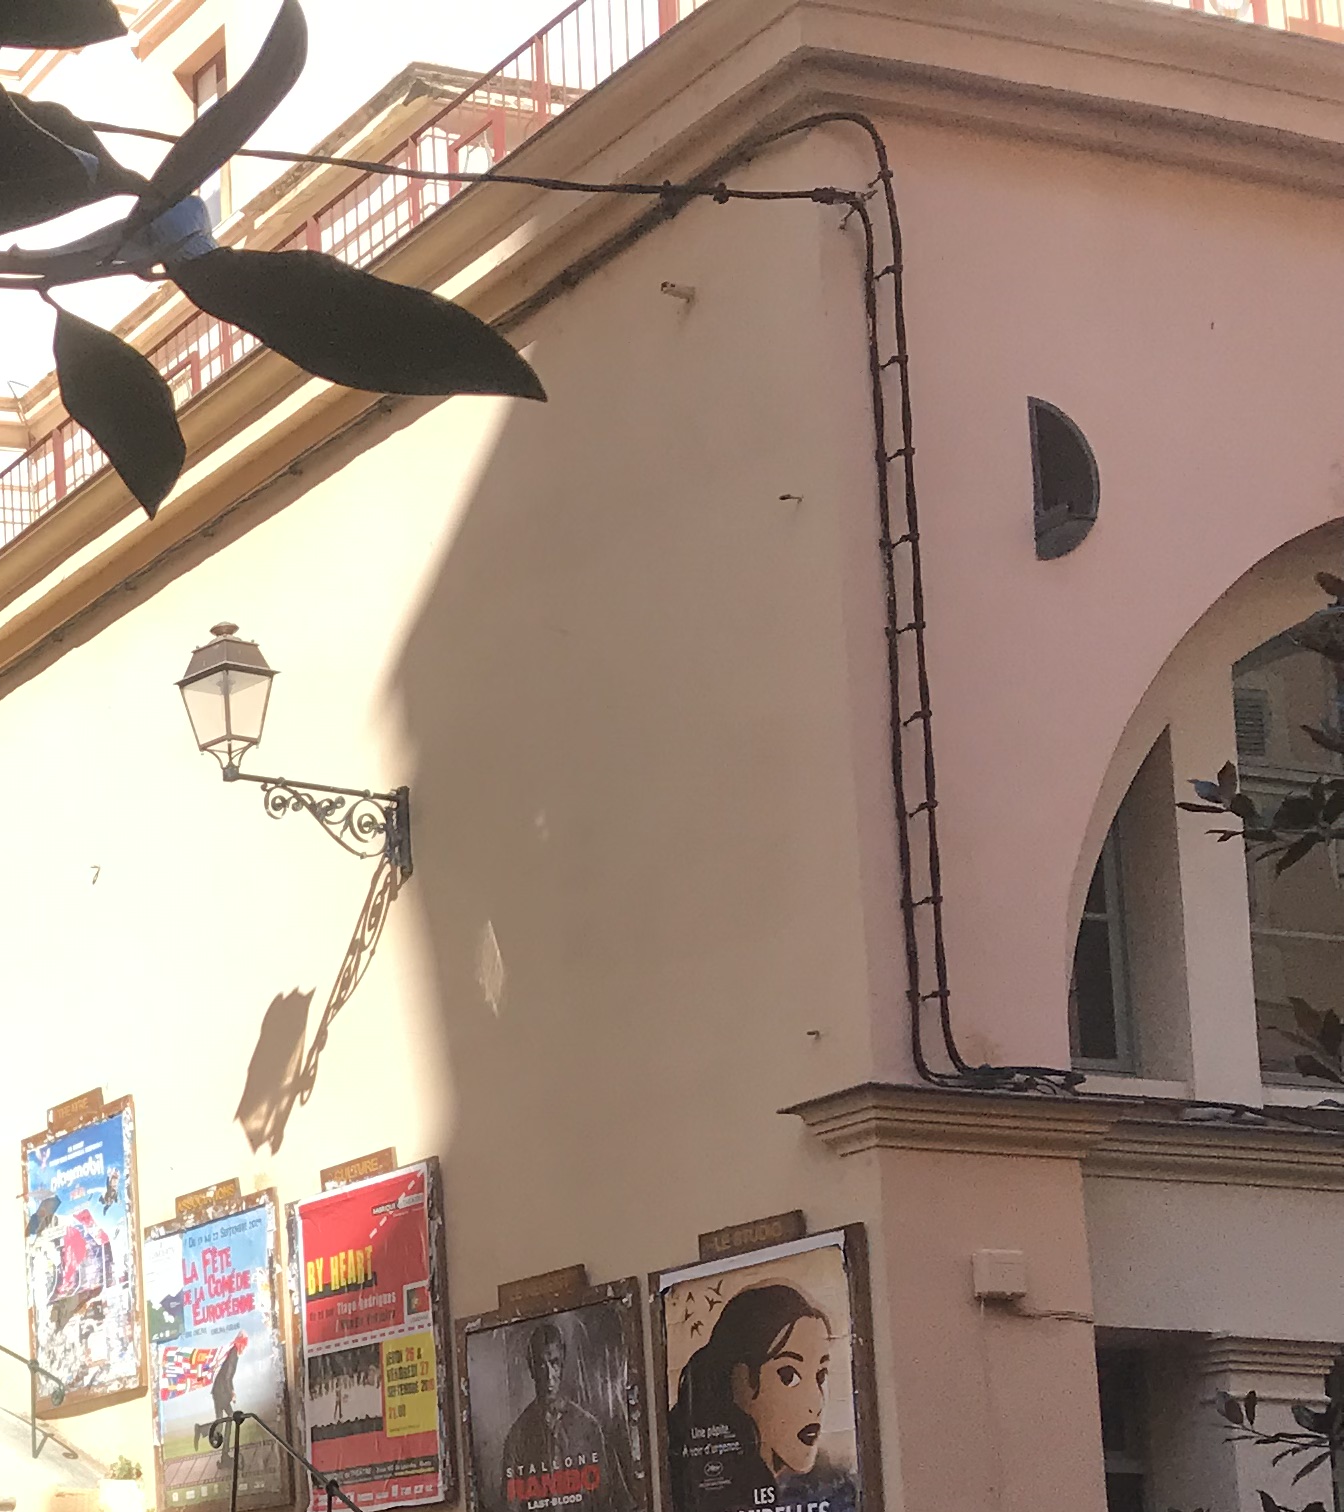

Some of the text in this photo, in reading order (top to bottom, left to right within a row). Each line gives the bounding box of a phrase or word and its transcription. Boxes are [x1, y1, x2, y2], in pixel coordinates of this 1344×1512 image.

[182, 1258, 199, 1286] LA
[307, 1245, 374, 1297] BY HEART
[505, 1452, 600, 1478] STALLONE
[506, 1464, 601, 1505] RAMBO
[754, 1486, 776, 1505] LES
[527, 1493, 583, 1511] LAST BLOOD
